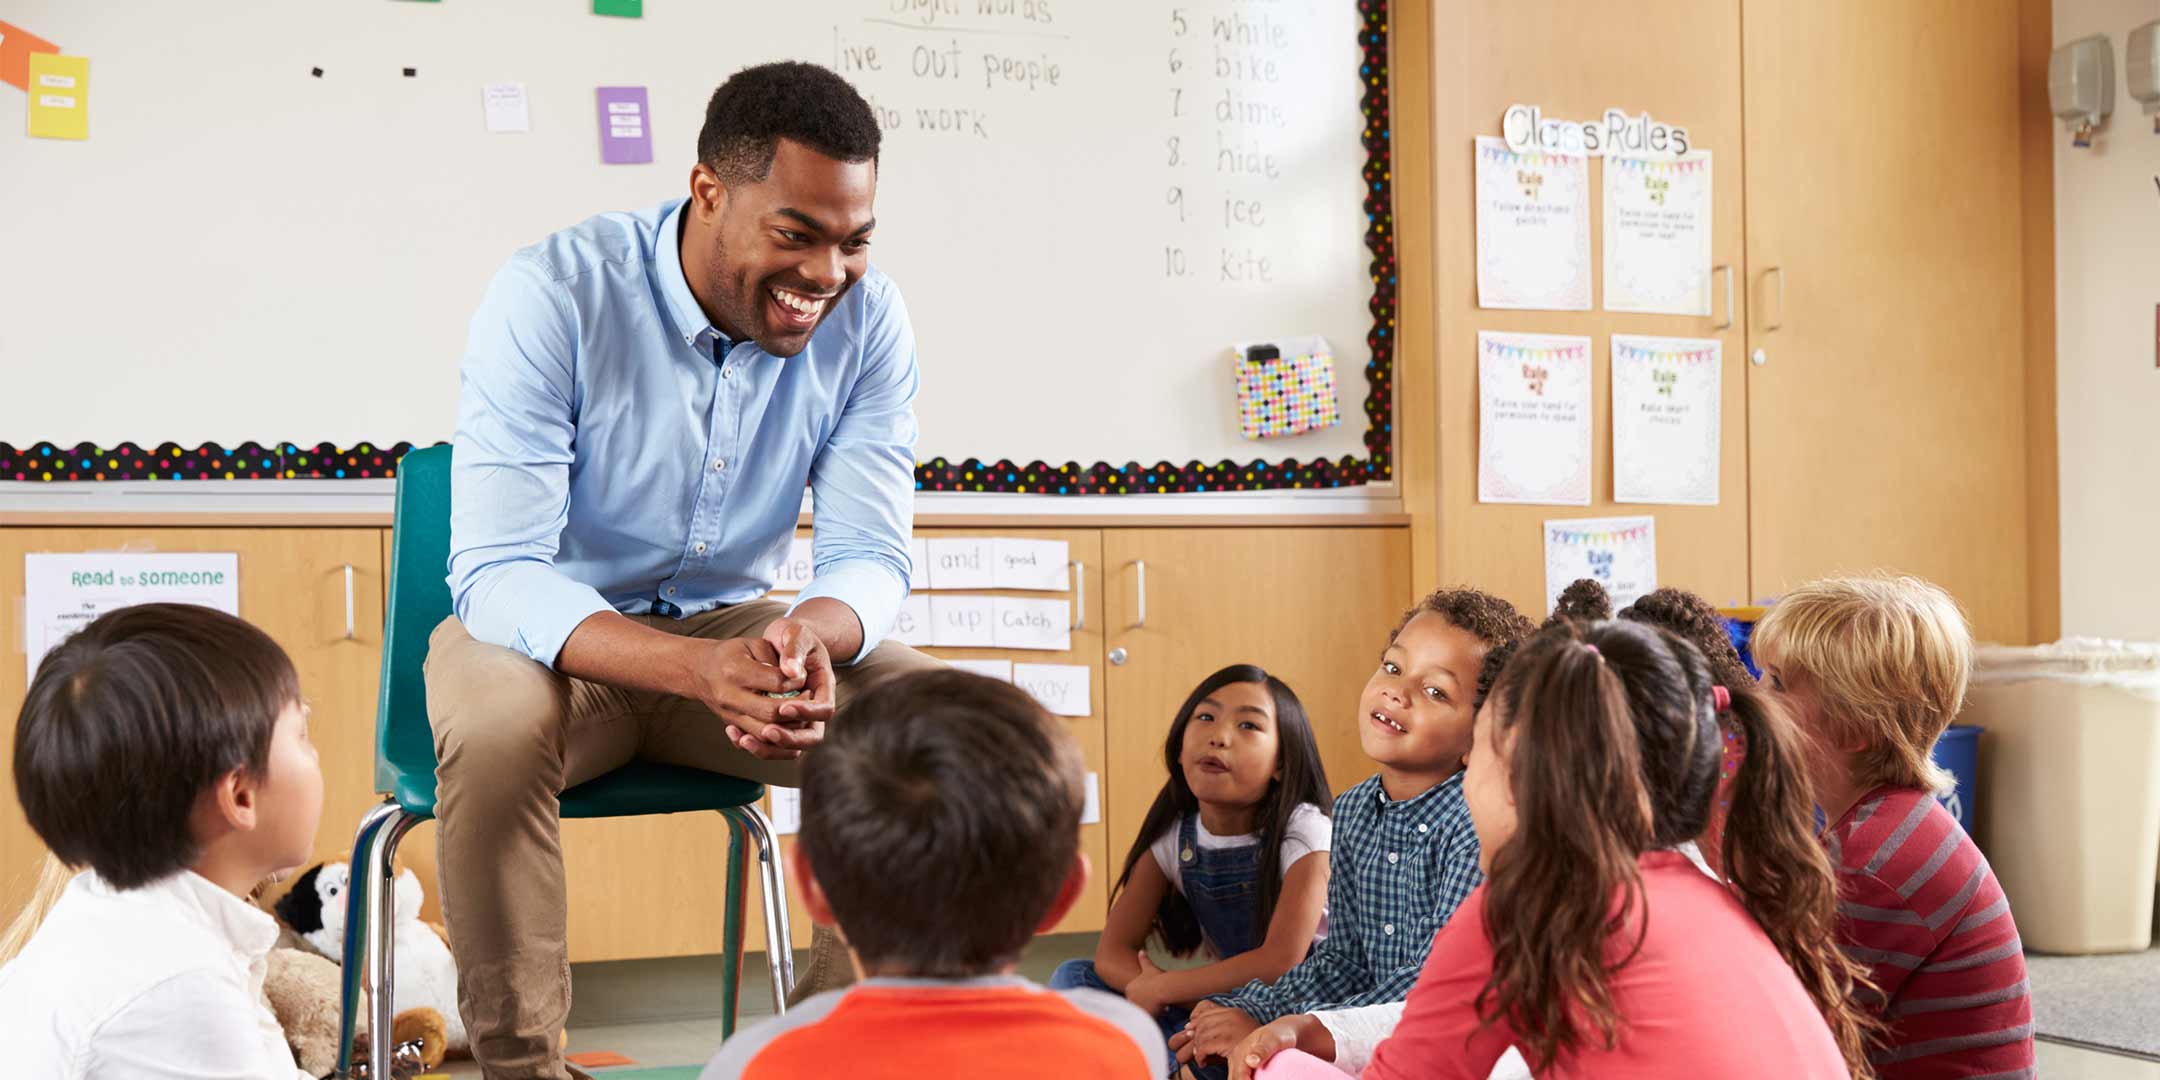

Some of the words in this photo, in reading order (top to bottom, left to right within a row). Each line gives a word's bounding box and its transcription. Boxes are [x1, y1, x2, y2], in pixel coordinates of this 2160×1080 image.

[1212, 10, 1288, 48] while
[983, 54, 1061, 91] people
[1215, 42, 1279, 82] bike
[915, 106, 989, 139] work
[1216, 87, 1287, 128] dime
[1510, 106, 1600, 151] Class
[1607, 111, 1689, 156] Rules
[1217, 128, 1280, 179] hide
[1224, 188, 1265, 229] ice
[940, 546, 981, 571] and
[71, 569, 114, 587] Read
[138, 570, 224, 587] someone
[947, 609, 982, 633] up
